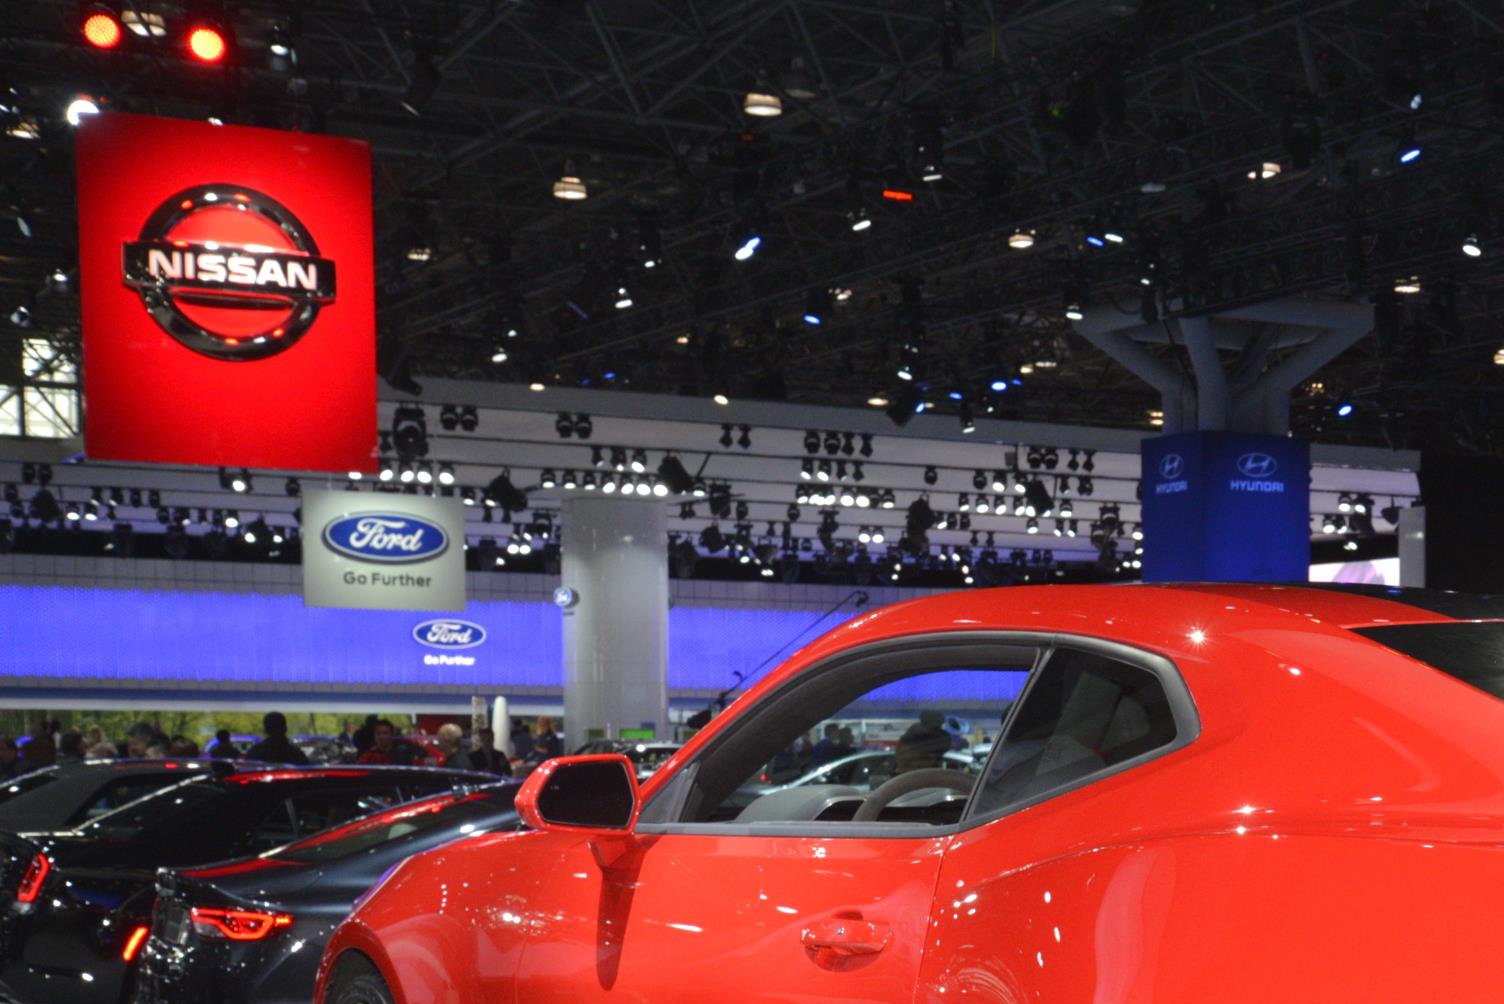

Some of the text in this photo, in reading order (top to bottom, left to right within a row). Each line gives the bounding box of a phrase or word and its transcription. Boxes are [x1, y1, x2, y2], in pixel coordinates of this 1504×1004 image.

[148, 249, 318, 290] NISSAN
[1155, 480, 1188, 494] HYUNDAI
[1230, 480, 1284, 493] HYUNDAI
[349, 517, 424, 551] Ford
[343, 571, 432, 587] Go Further
[426, 623, 473, 643] Ford
[423, 654, 476, 666] Go Further
